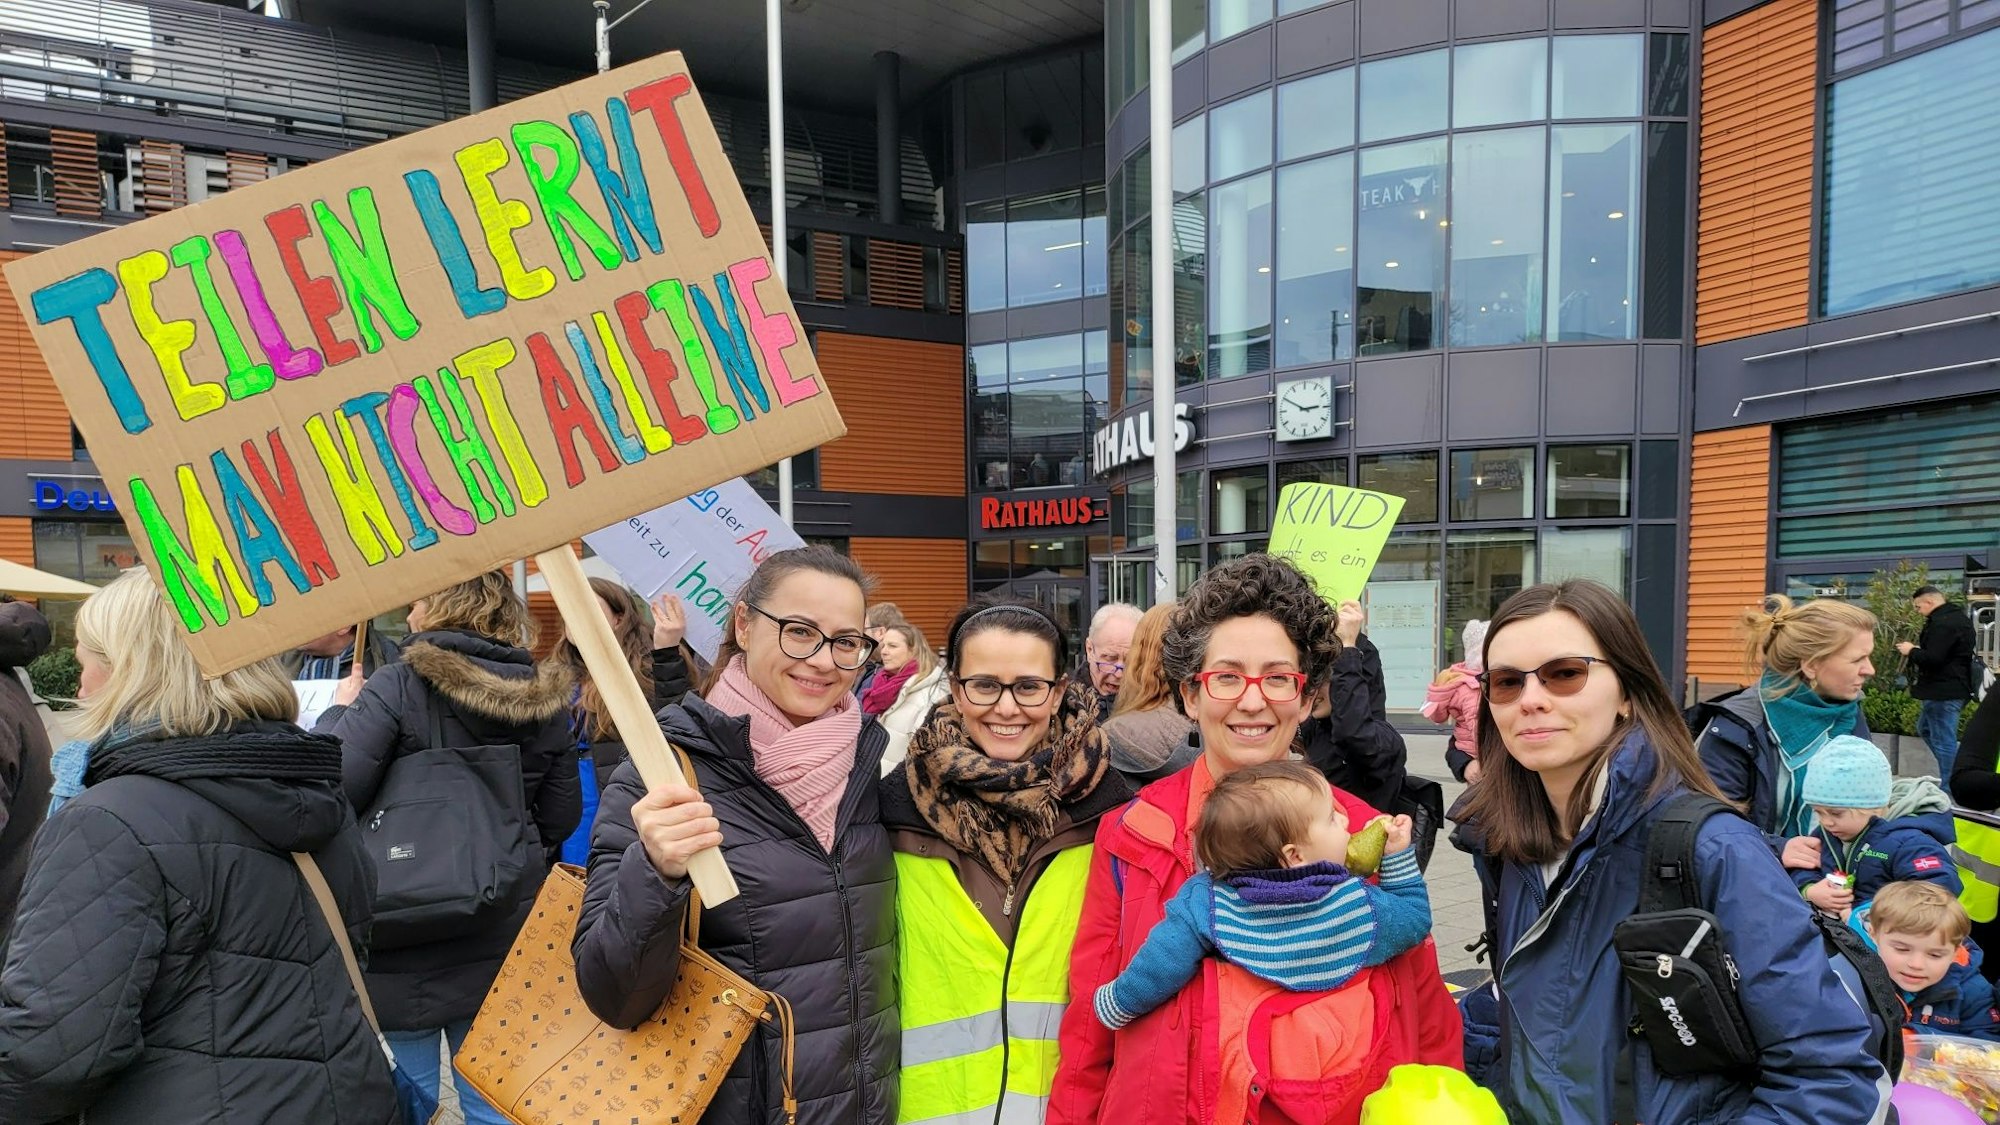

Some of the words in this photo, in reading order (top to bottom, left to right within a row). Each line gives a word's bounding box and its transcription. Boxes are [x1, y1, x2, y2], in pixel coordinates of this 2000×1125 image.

[31, 187, 420, 434] TEILEN
[403, 73, 721, 319] LERNT
[129, 428, 340, 633] MAN
[304, 337, 549, 566] NICHT
[525, 257, 821, 488] ALLEINE
[716, 506, 745, 532] der
[1282, 485, 1388, 529] KIND
[649, 538, 670, 558] zu
[1310, 550, 1327, 562] es
[1340, 548, 1366, 568] ein
